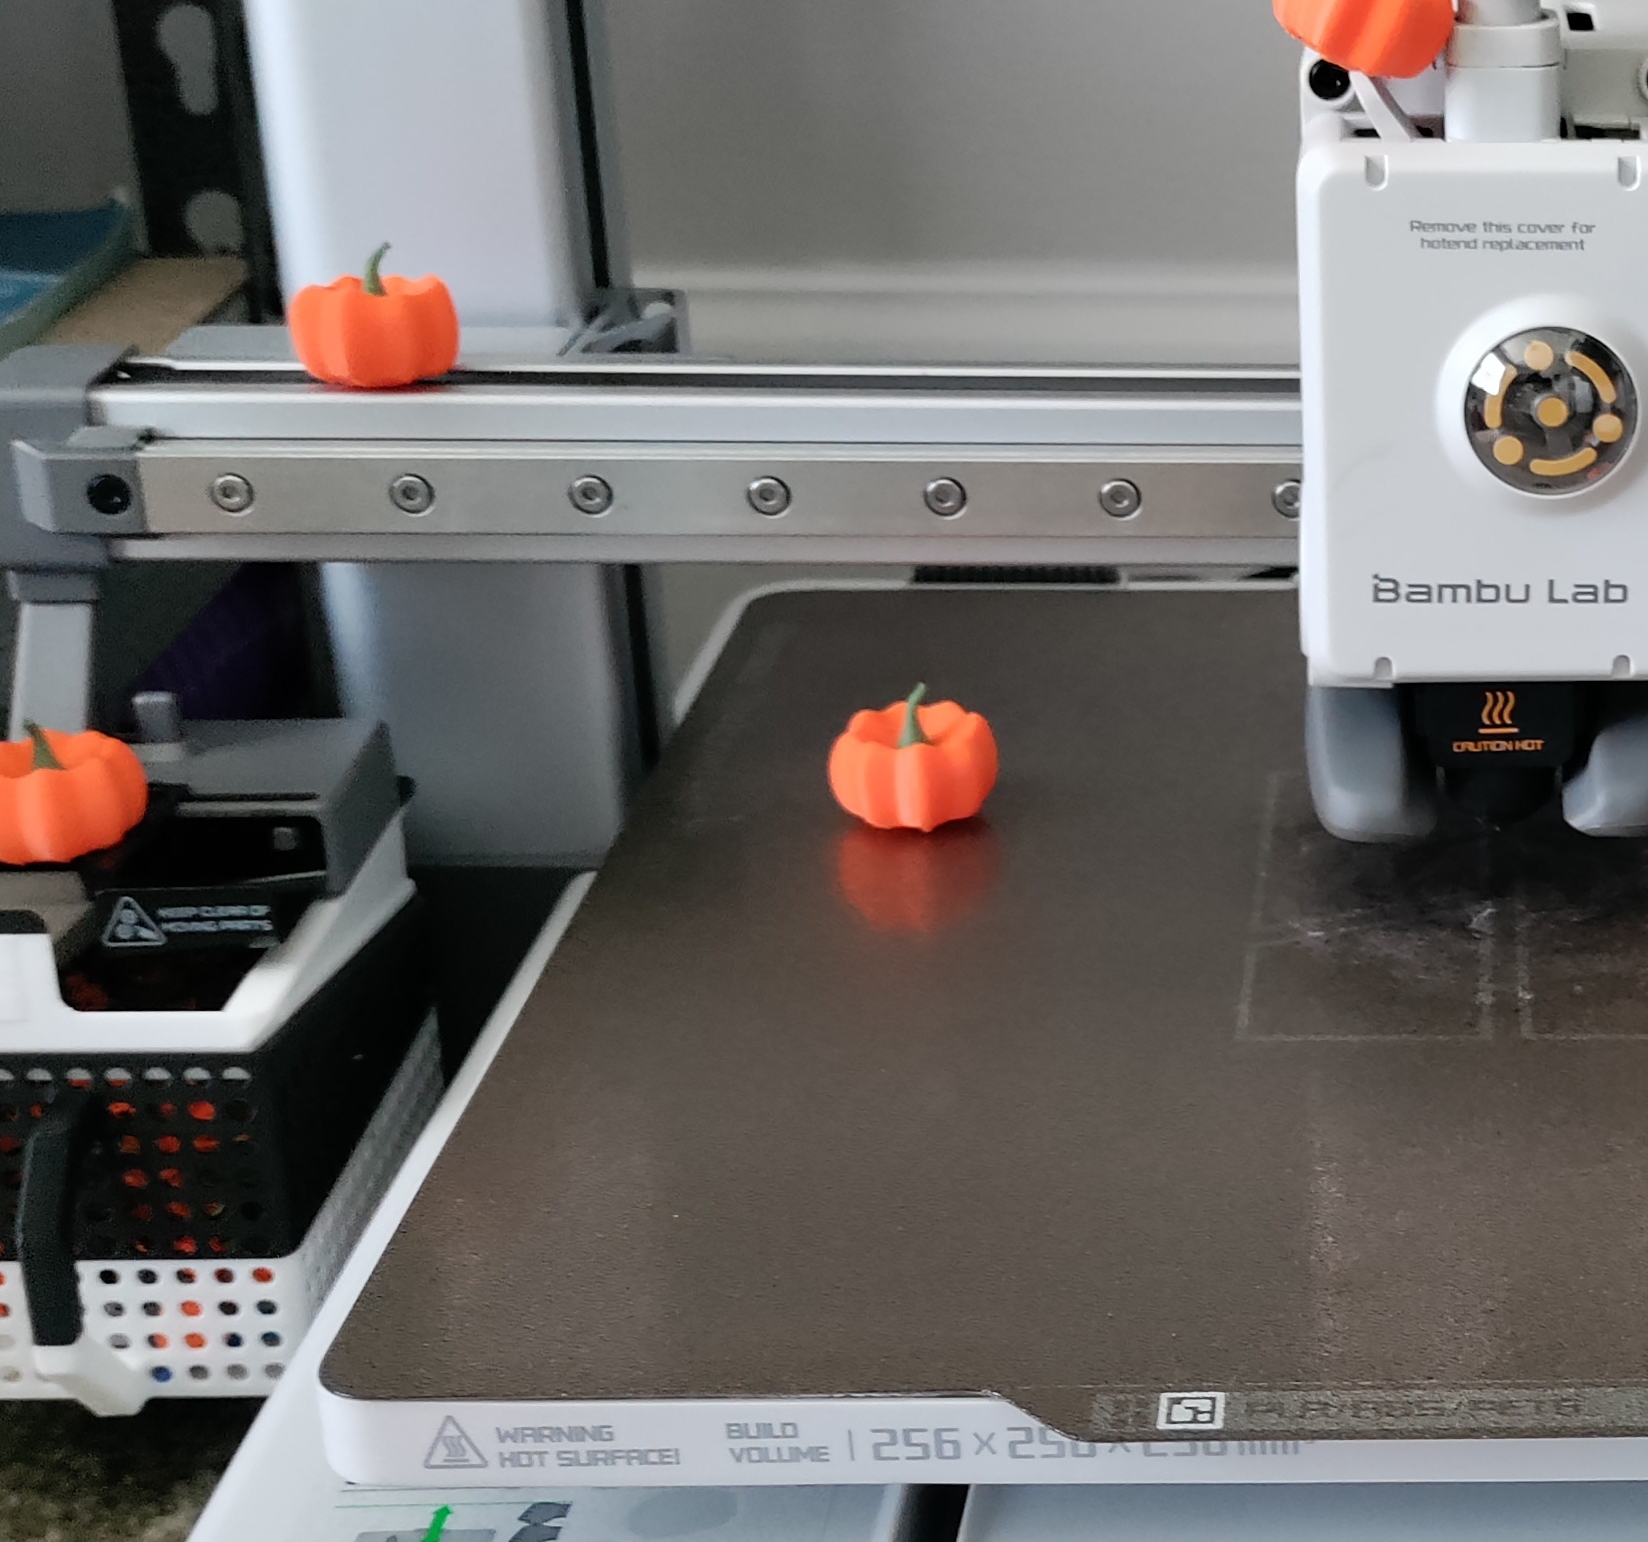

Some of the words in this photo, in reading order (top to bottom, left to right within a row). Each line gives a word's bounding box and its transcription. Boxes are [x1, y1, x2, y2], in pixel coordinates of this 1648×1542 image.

[1409, 219, 1477, 233] Remove
[1482, 221, 1512, 233] this
[1517, 222, 1565, 234] cover
[1571, 221, 1596, 234] for
[1420, 237, 1478, 250] hotend
[1482, 238, 1585, 252] replacement
[1372, 573, 1531, 604] Bambu
[1547, 578, 1628, 604] Lab
[496, 1425, 614, 1443] WARNING
[725, 1422, 798, 1439] BUILD
[870, 1428, 961, 1461] 256
[499, 1450, 548, 1468] HOT
[556, 1448, 681, 1467] SURFACE!
[728, 1446, 830, 1463] VOLUME
